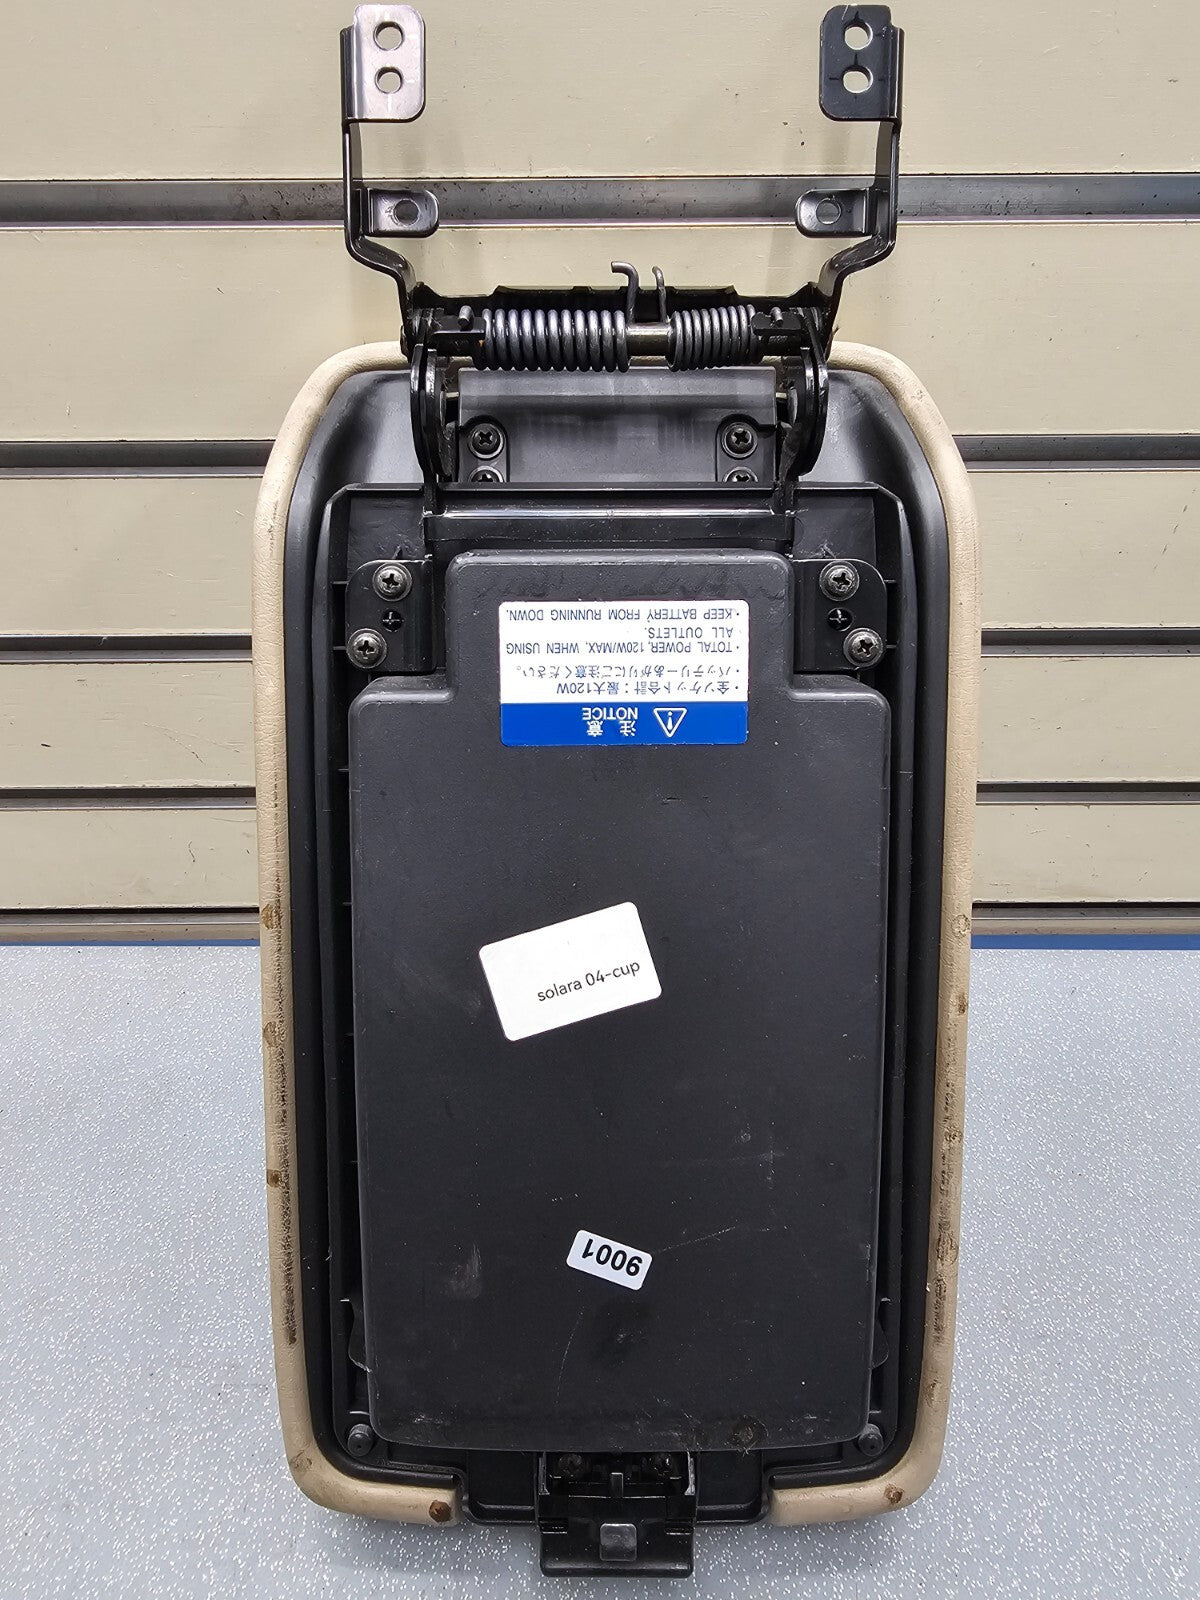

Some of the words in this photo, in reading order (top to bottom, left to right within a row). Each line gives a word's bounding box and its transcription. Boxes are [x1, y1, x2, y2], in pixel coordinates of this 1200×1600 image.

[506, 609, 544, 621] DOWN.
[550, 609, 602, 621] RUNNING
[608, 609, 640, 621] FROM
[646, 608, 697, 620] BATTERY
[703, 608, 733, 619] KEEP
[644, 627, 703, 639] OUTLETS.
[711, 627, 733, 638] ALL
[506, 642, 540, 654] USING
[546, 642, 579, 654] WHEN
[697, 641, 732, 653] TOTAL
[581, 706, 638, 720] NOTICE
[537, 983, 583, 1002] solara
[585, 961, 640, 986] 04-cup
[581, 1238, 643, 1277] 9001
